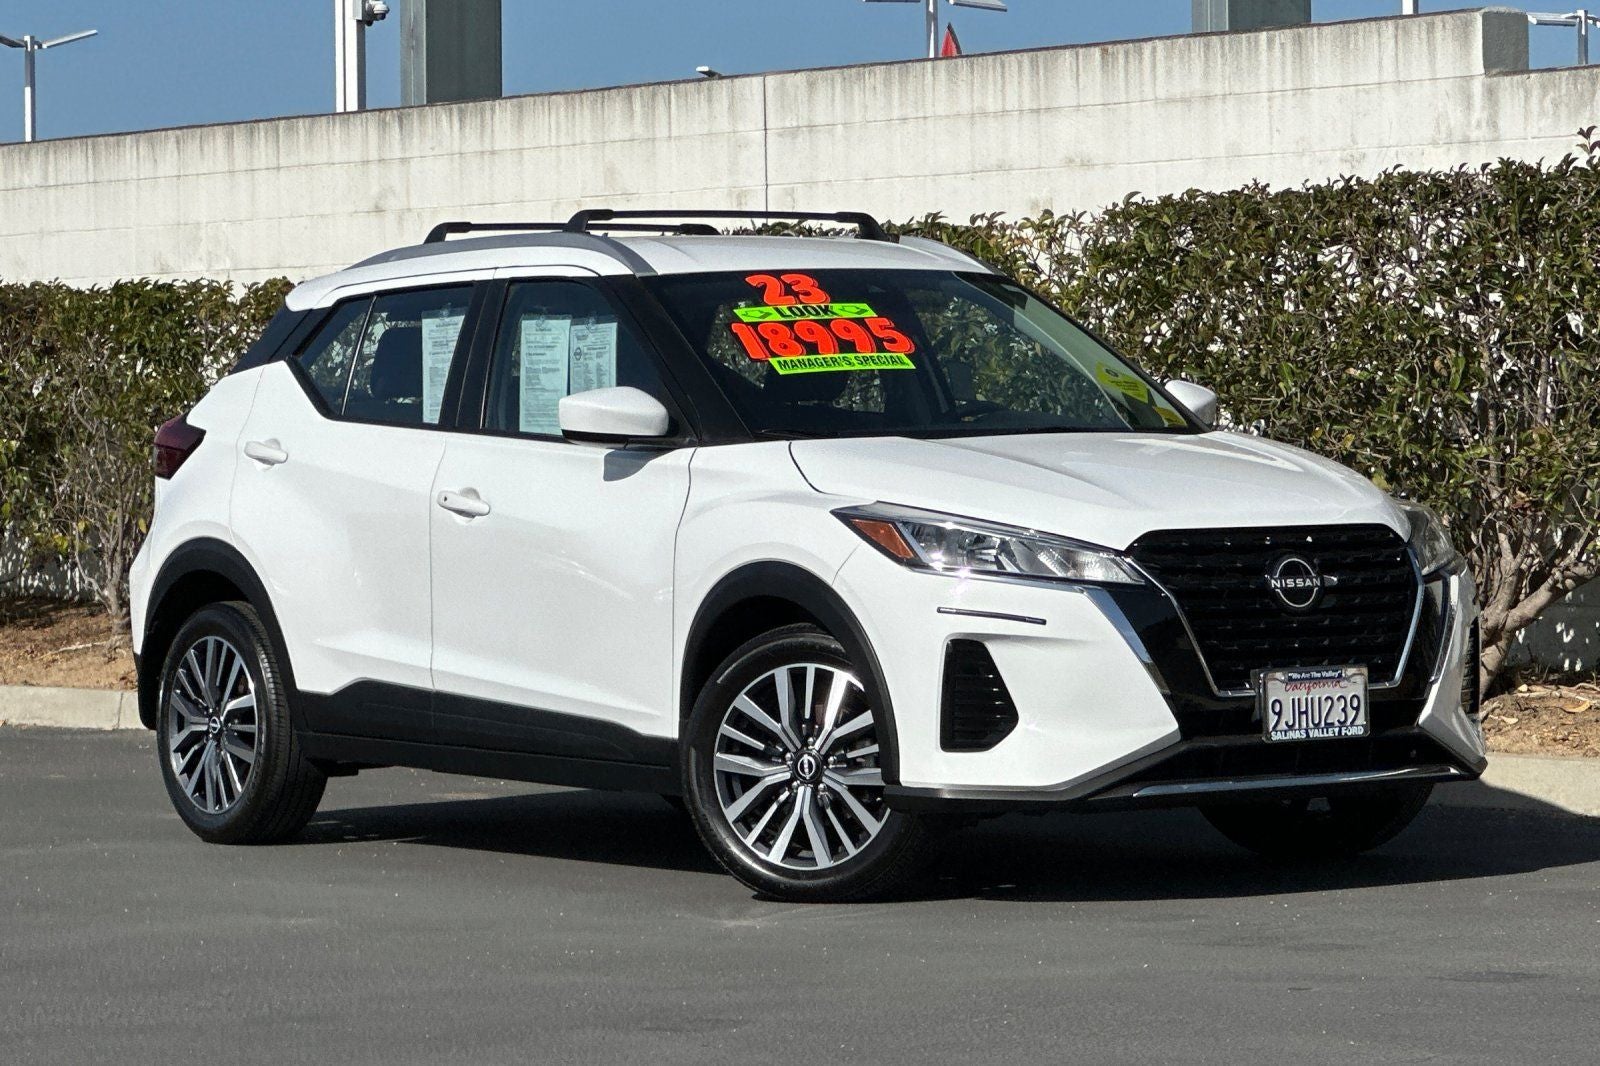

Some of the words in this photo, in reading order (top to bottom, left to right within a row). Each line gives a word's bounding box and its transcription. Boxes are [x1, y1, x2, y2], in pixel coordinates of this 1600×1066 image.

[745, 273, 830, 305] 23
[773, 304, 840, 318] LOOK
[731, 317, 915, 361] 18995
[777, 357, 853, 371] MANAGER'S
[855, 355, 908, 366] SPECIAL
[1271, 578, 1320, 588] NISSAN
[1271, 694, 1361, 731] 9JHU239
[1271, 729, 1307, 740] SALINAS
[1308, 727, 1339, 738] VALLEY
[1341, 726, 1364, 735] FORD
